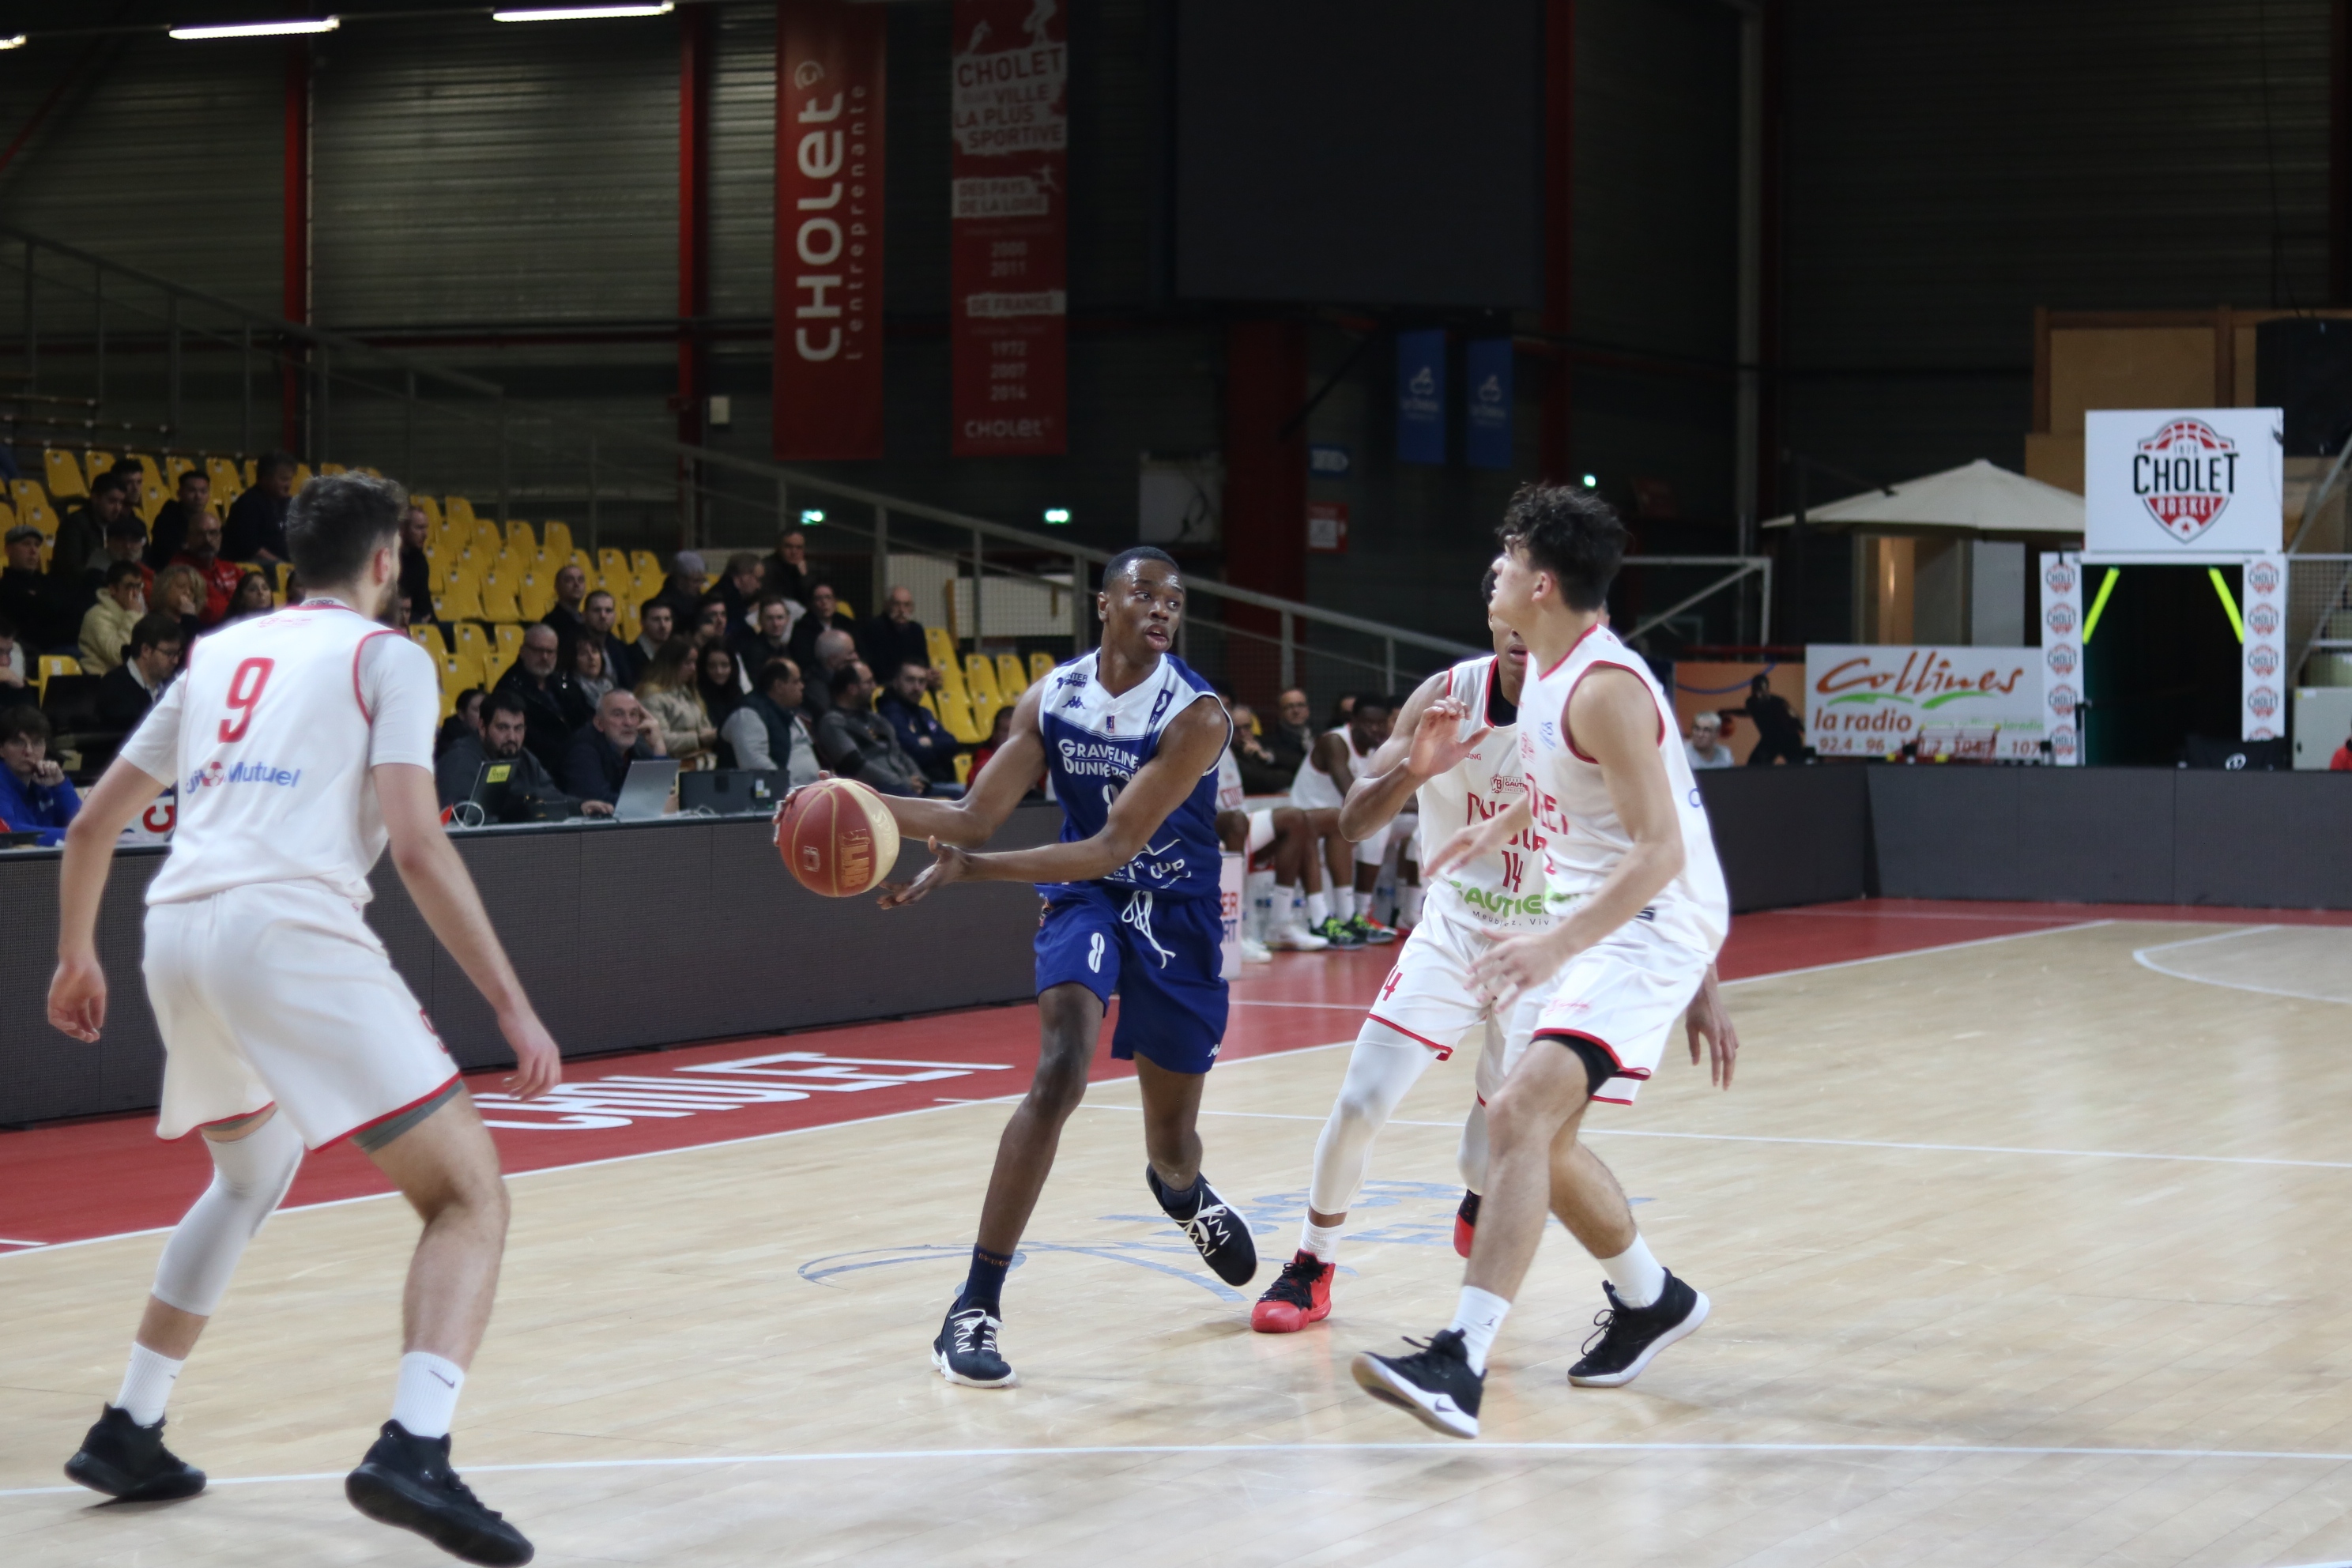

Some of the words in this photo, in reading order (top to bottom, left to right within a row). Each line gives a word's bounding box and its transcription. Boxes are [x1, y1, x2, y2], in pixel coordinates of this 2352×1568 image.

[958, 47, 1061, 87] CHOLET
[995, 84, 1049, 104] VILLE
[953, 111, 978, 128] LA
[984, 105, 1034, 125] PLUS
[968, 123, 1061, 149] SPORTIVE
[2133, 452, 2240, 495] CHOLET
[2156, 496, 2216, 517] BASKET
[1815, 650, 2024, 695] Collines
[217, 656, 275, 744] 9
[1814, 708, 1838, 732] la
[1844, 707, 1913, 733] radio
[1057, 738, 1140, 770] GRAVELINE
[1865, 737, 1885, 752] 96
[228, 761, 302, 788] Mutuel
[1150, 858, 1185, 880] CUP
[1501, 850, 1524, 893] 14
[1087, 932, 1106, 974] 8
[471, 1051, 1015, 1131] CHOLET
